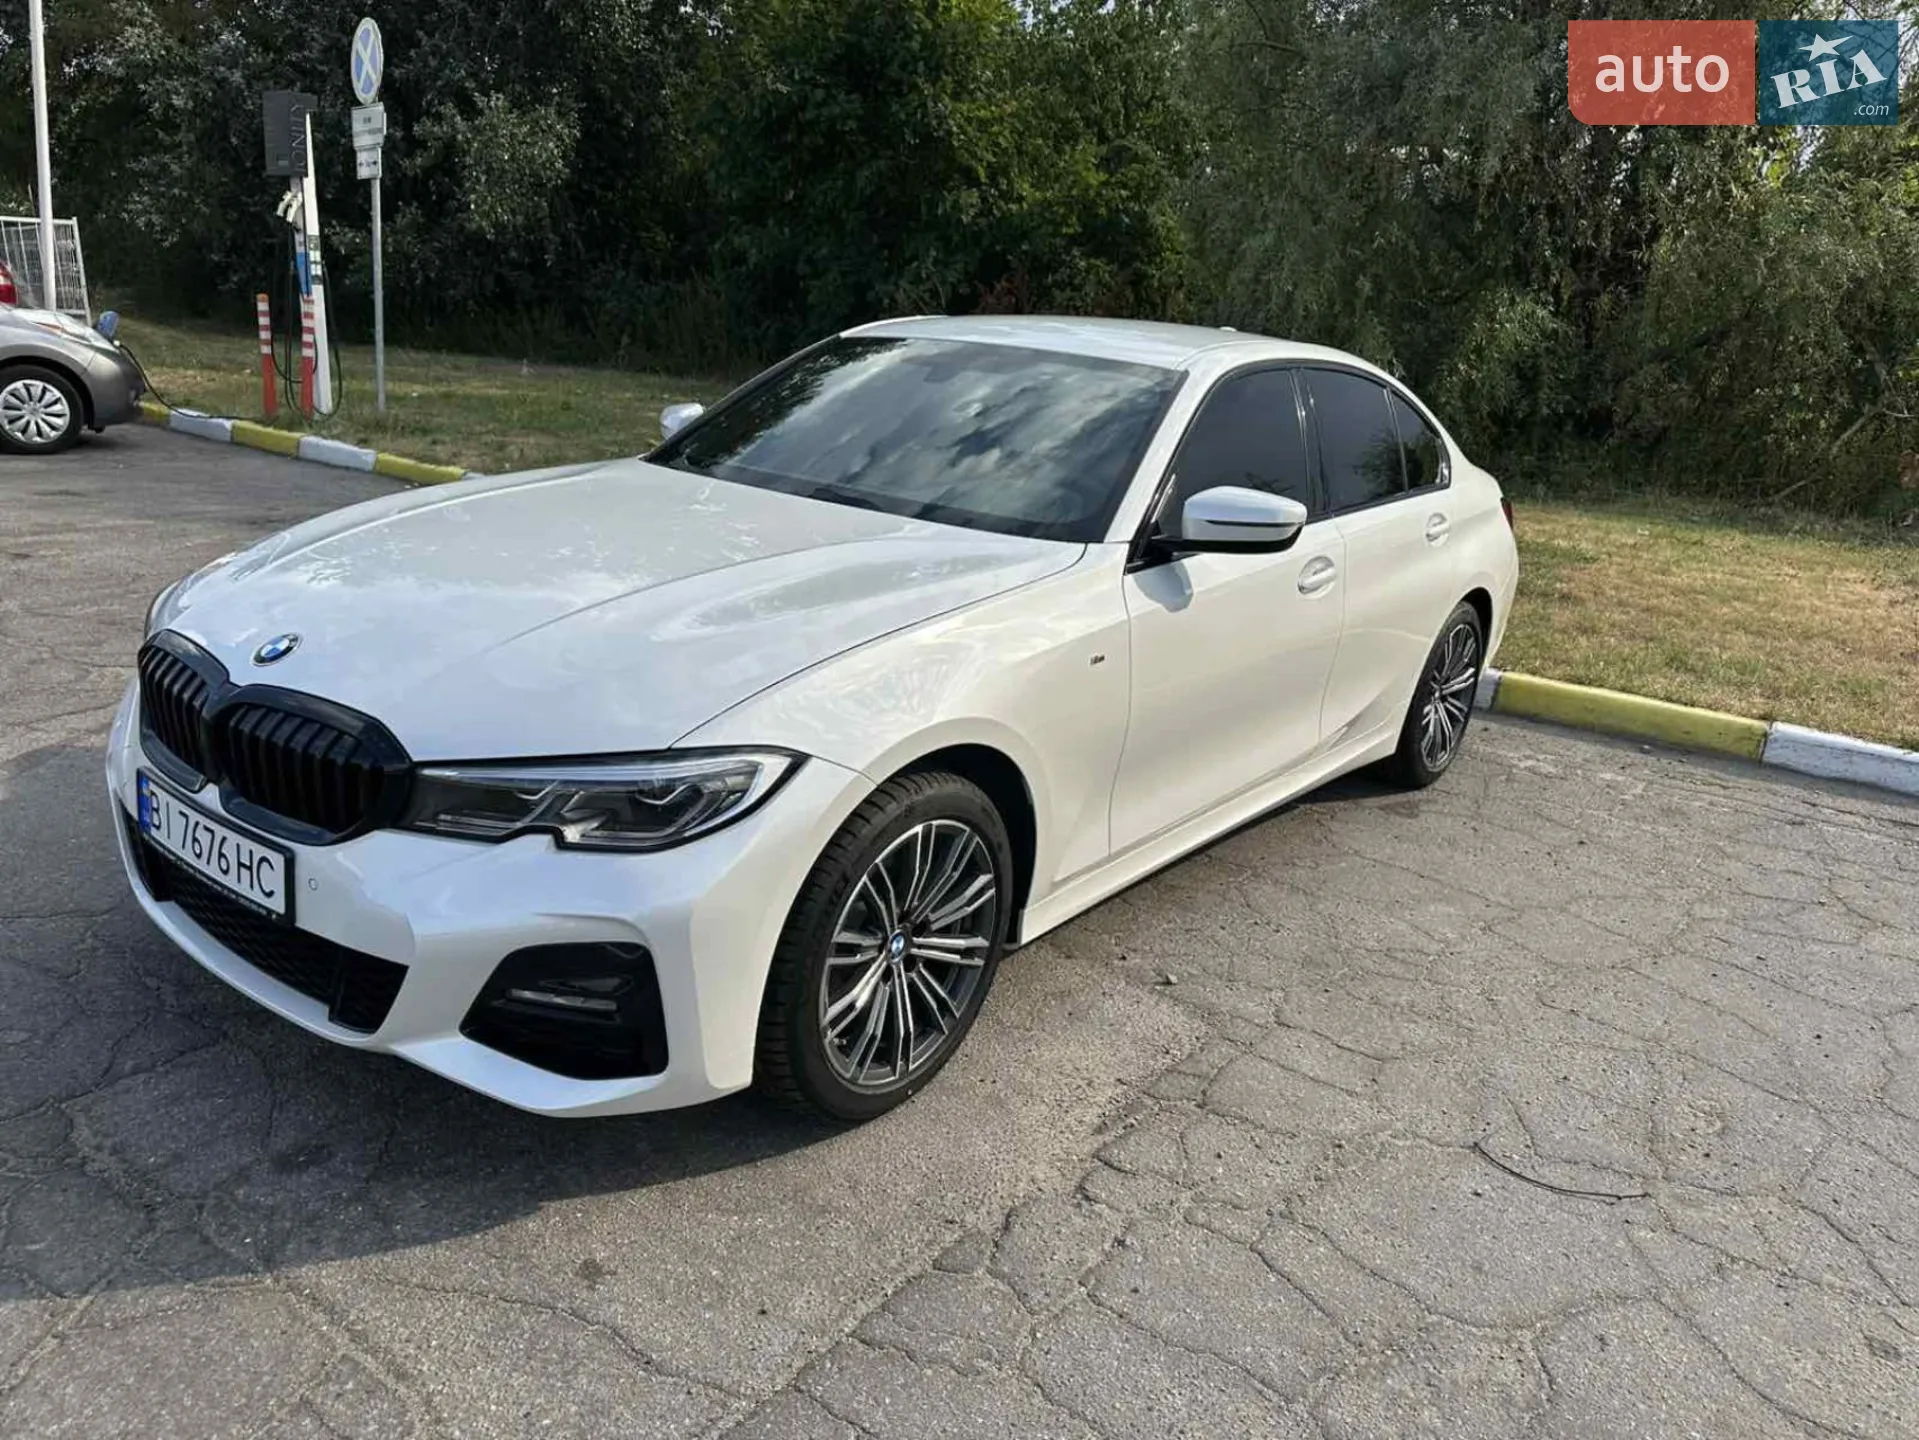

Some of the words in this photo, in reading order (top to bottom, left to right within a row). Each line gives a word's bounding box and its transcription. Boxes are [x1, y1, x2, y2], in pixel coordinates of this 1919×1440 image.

[290, 99, 306, 173] IONITY
[150, 791, 171, 839] BI
[178, 810, 230, 875] 7676
[236, 843, 276, 899] HC
